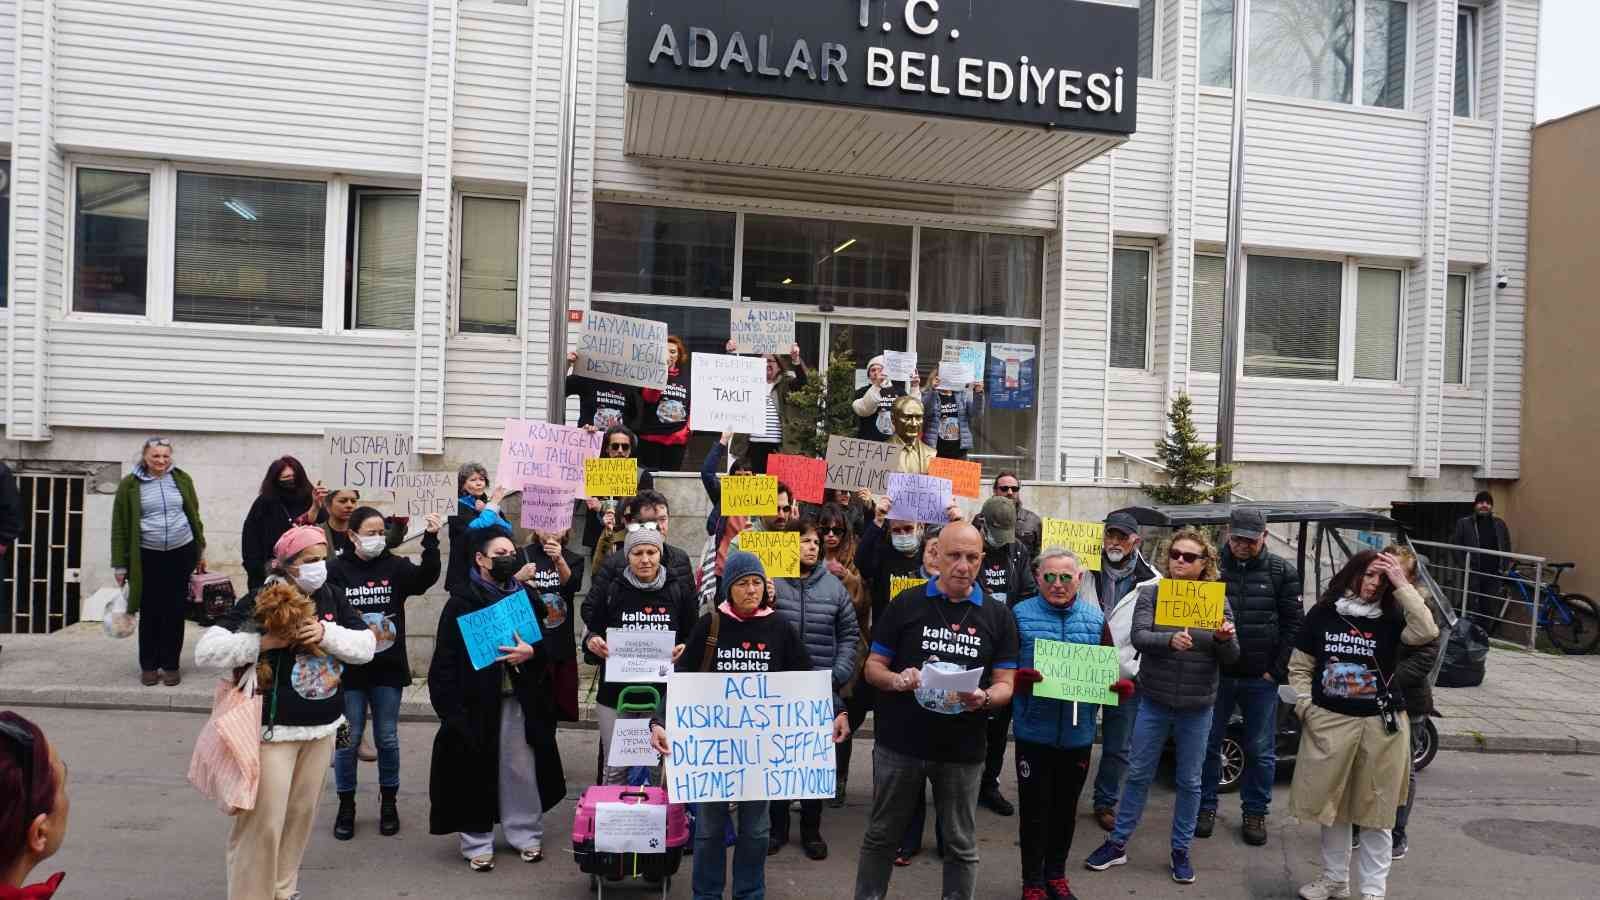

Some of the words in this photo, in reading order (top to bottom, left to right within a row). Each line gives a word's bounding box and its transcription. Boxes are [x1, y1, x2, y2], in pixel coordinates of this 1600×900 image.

[648, 24, 848, 83] ADALAR
[866, 47, 1123, 113] BELEDİYESİ
[330, 436, 389, 456] MUSTAFA
[622, 611, 671, 622] kalbimiz
[923, 626, 981, 646] kalbimiz
[1325, 631, 1377, 648] kalbimiz
[717, 647, 771, 660] kalbimiz
[921, 640, 979, 658] sokakta
[1324, 643, 1374, 657] sokakta
[717, 660, 769, 671] sokakta
[725, 674, 781, 700] ACİL
[675, 697, 834, 731] KISIRLAŞTIRMA
[672, 734, 761, 767] DÜZENLİ
[768, 730, 833, 768] ŞEFFAF
[675, 768, 746, 800] HİZMET
[763, 766, 836, 796] İSTİYORUZ
